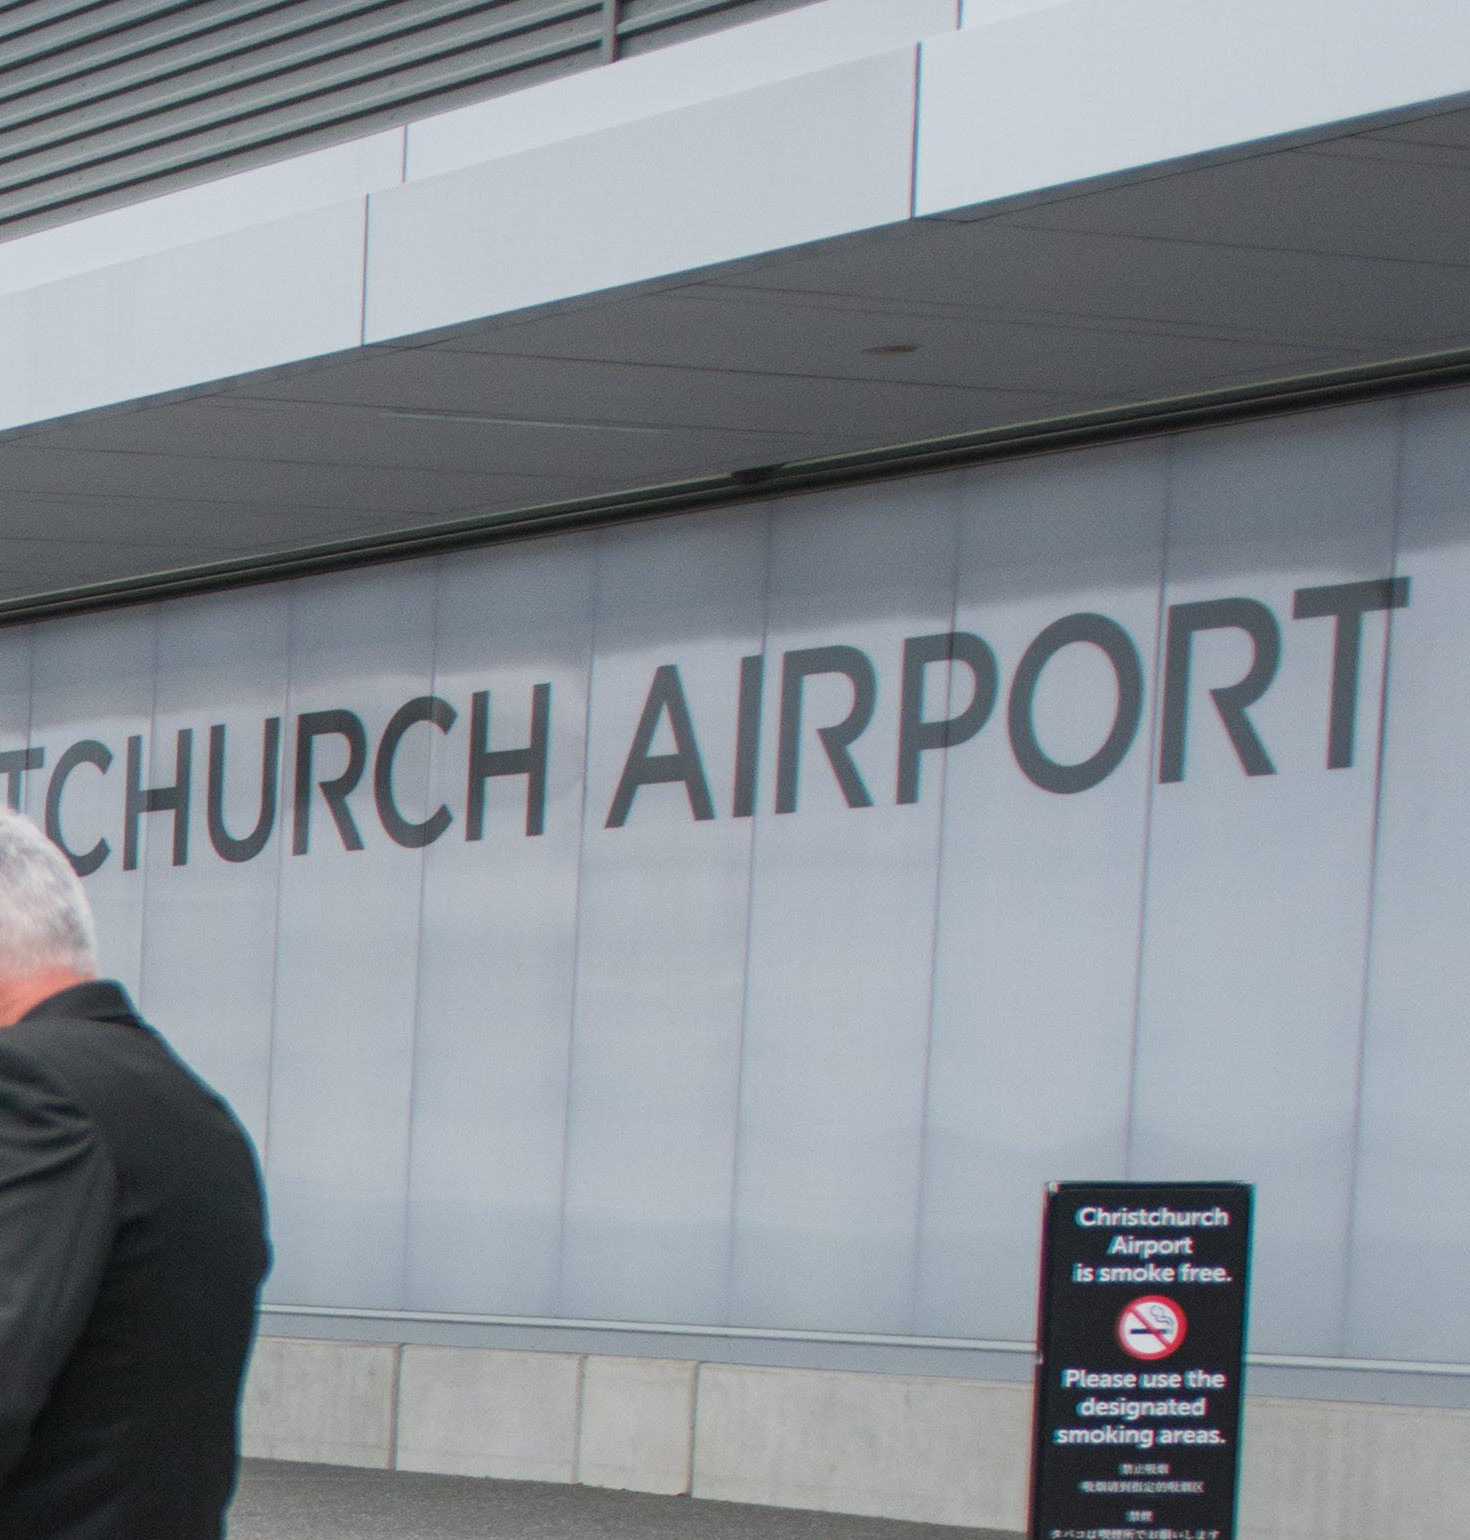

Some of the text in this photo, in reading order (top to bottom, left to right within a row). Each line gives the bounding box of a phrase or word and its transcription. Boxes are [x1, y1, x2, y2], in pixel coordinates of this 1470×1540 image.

[604, 576, 1411, 828] AIRPORT
[1076, 1207, 1231, 1227] Christchurch
[1108, 1235, 1193, 1259] Airport
[1074, 1263, 1232, 1282] is smoke free.
[1063, 1369, 1226, 1388] Please use the
[1077, 1398, 1207, 1420] designated
[1054, 1425, 1227, 1448] smoking areas.
